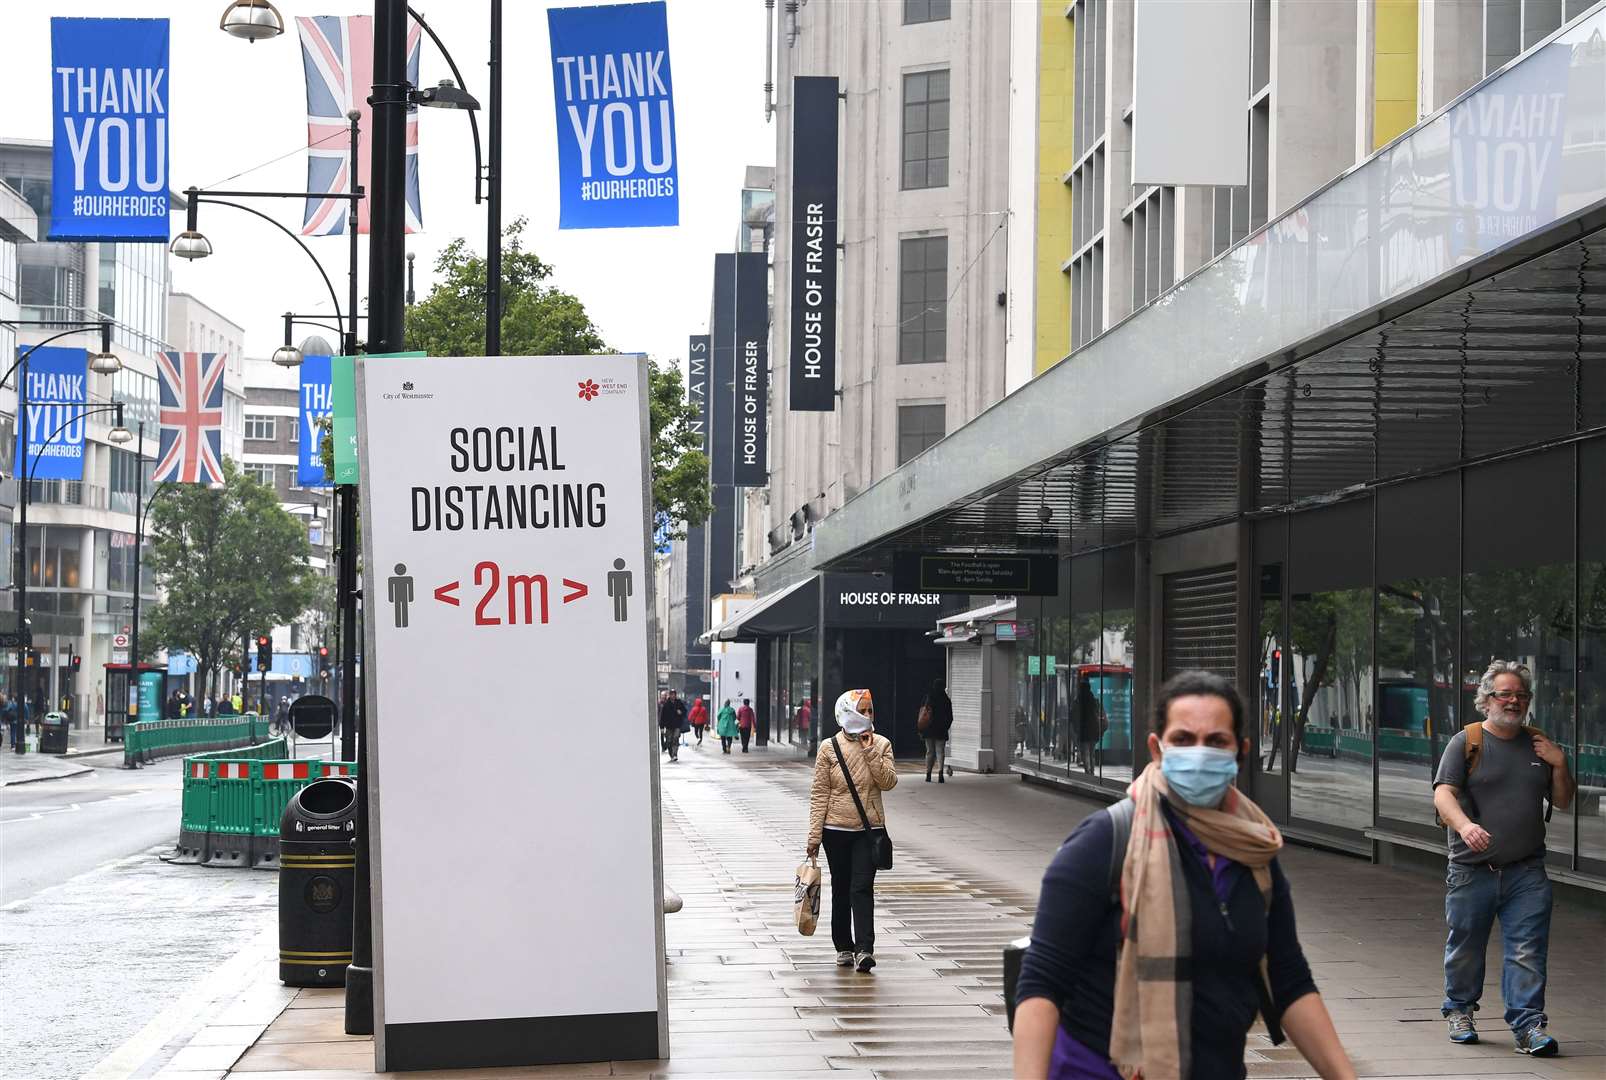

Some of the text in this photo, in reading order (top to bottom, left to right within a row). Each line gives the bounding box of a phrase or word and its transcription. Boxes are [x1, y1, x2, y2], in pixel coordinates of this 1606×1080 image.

[56, 67, 165, 114] THANK
[557, 51, 668, 101] THANK
[64, 117, 165, 192] YOU
[567, 100, 673, 178] YOU
[73, 195, 166, 217] #OURHEROES
[581, 177, 674, 201] #OURHEROES
[804, 203, 824, 378] HOUSE OF FRASER
[25, 372, 84, 401] THANK
[302, 383, 333, 410] THA
[743, 340, 758, 464] HOUSE OF FRASER
[26, 400, 84, 444] YOU
[450, 426, 566, 473] SOCIAL
[411, 483, 606, 532] DISTANCING
[474, 561, 549, 626] 2m
[840, 592, 940, 605] HOUSE OF FRASER
[307, 824, 327, 832] general
